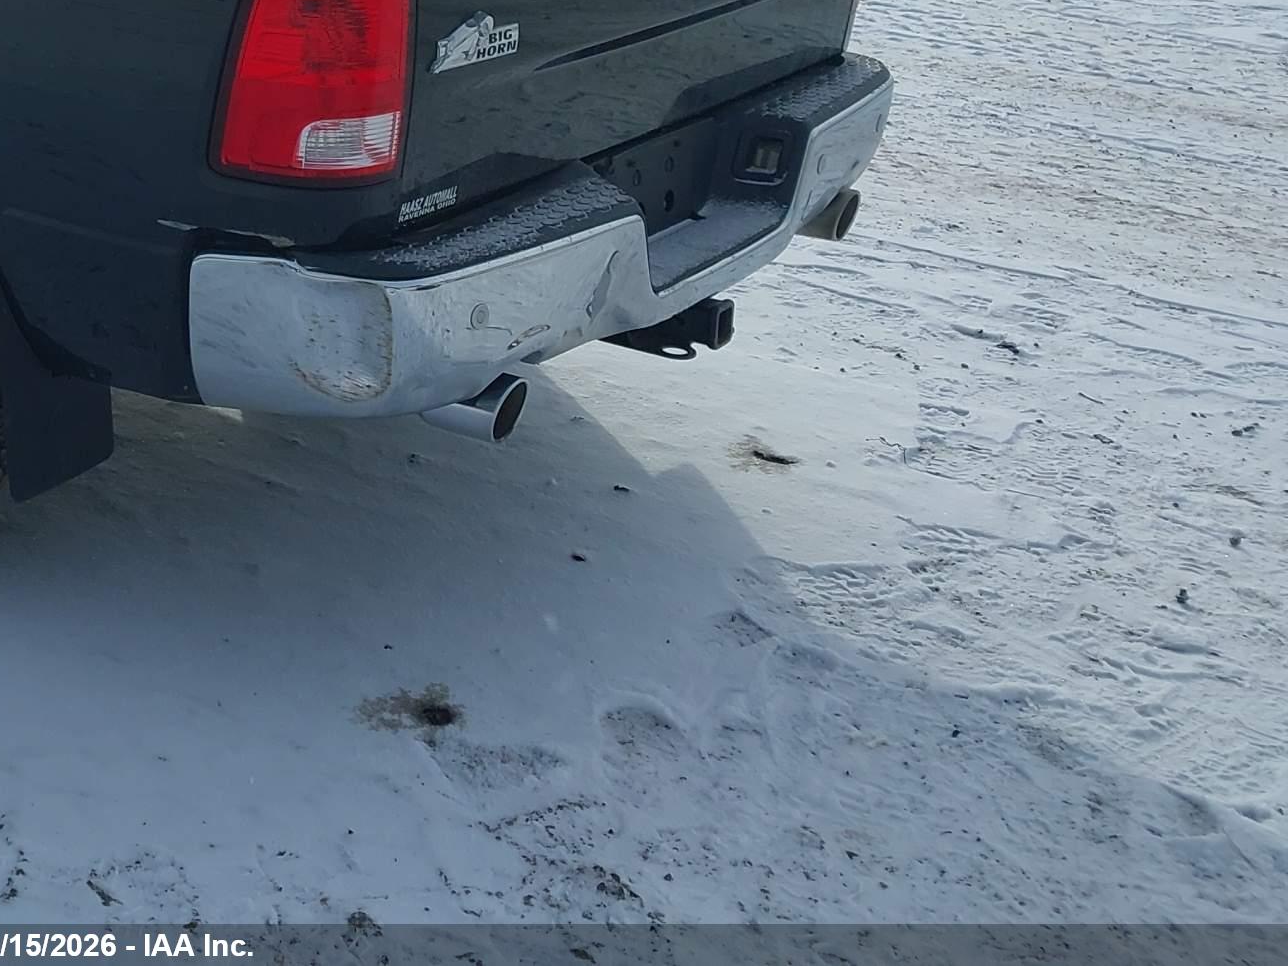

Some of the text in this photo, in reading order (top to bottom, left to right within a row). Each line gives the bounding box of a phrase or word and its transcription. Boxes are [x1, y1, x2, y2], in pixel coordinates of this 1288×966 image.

[488, 29, 513, 44] BIG
[476, 40, 517, 59] HORN
[398, 198, 456, 223] RAVENNA OHIO
